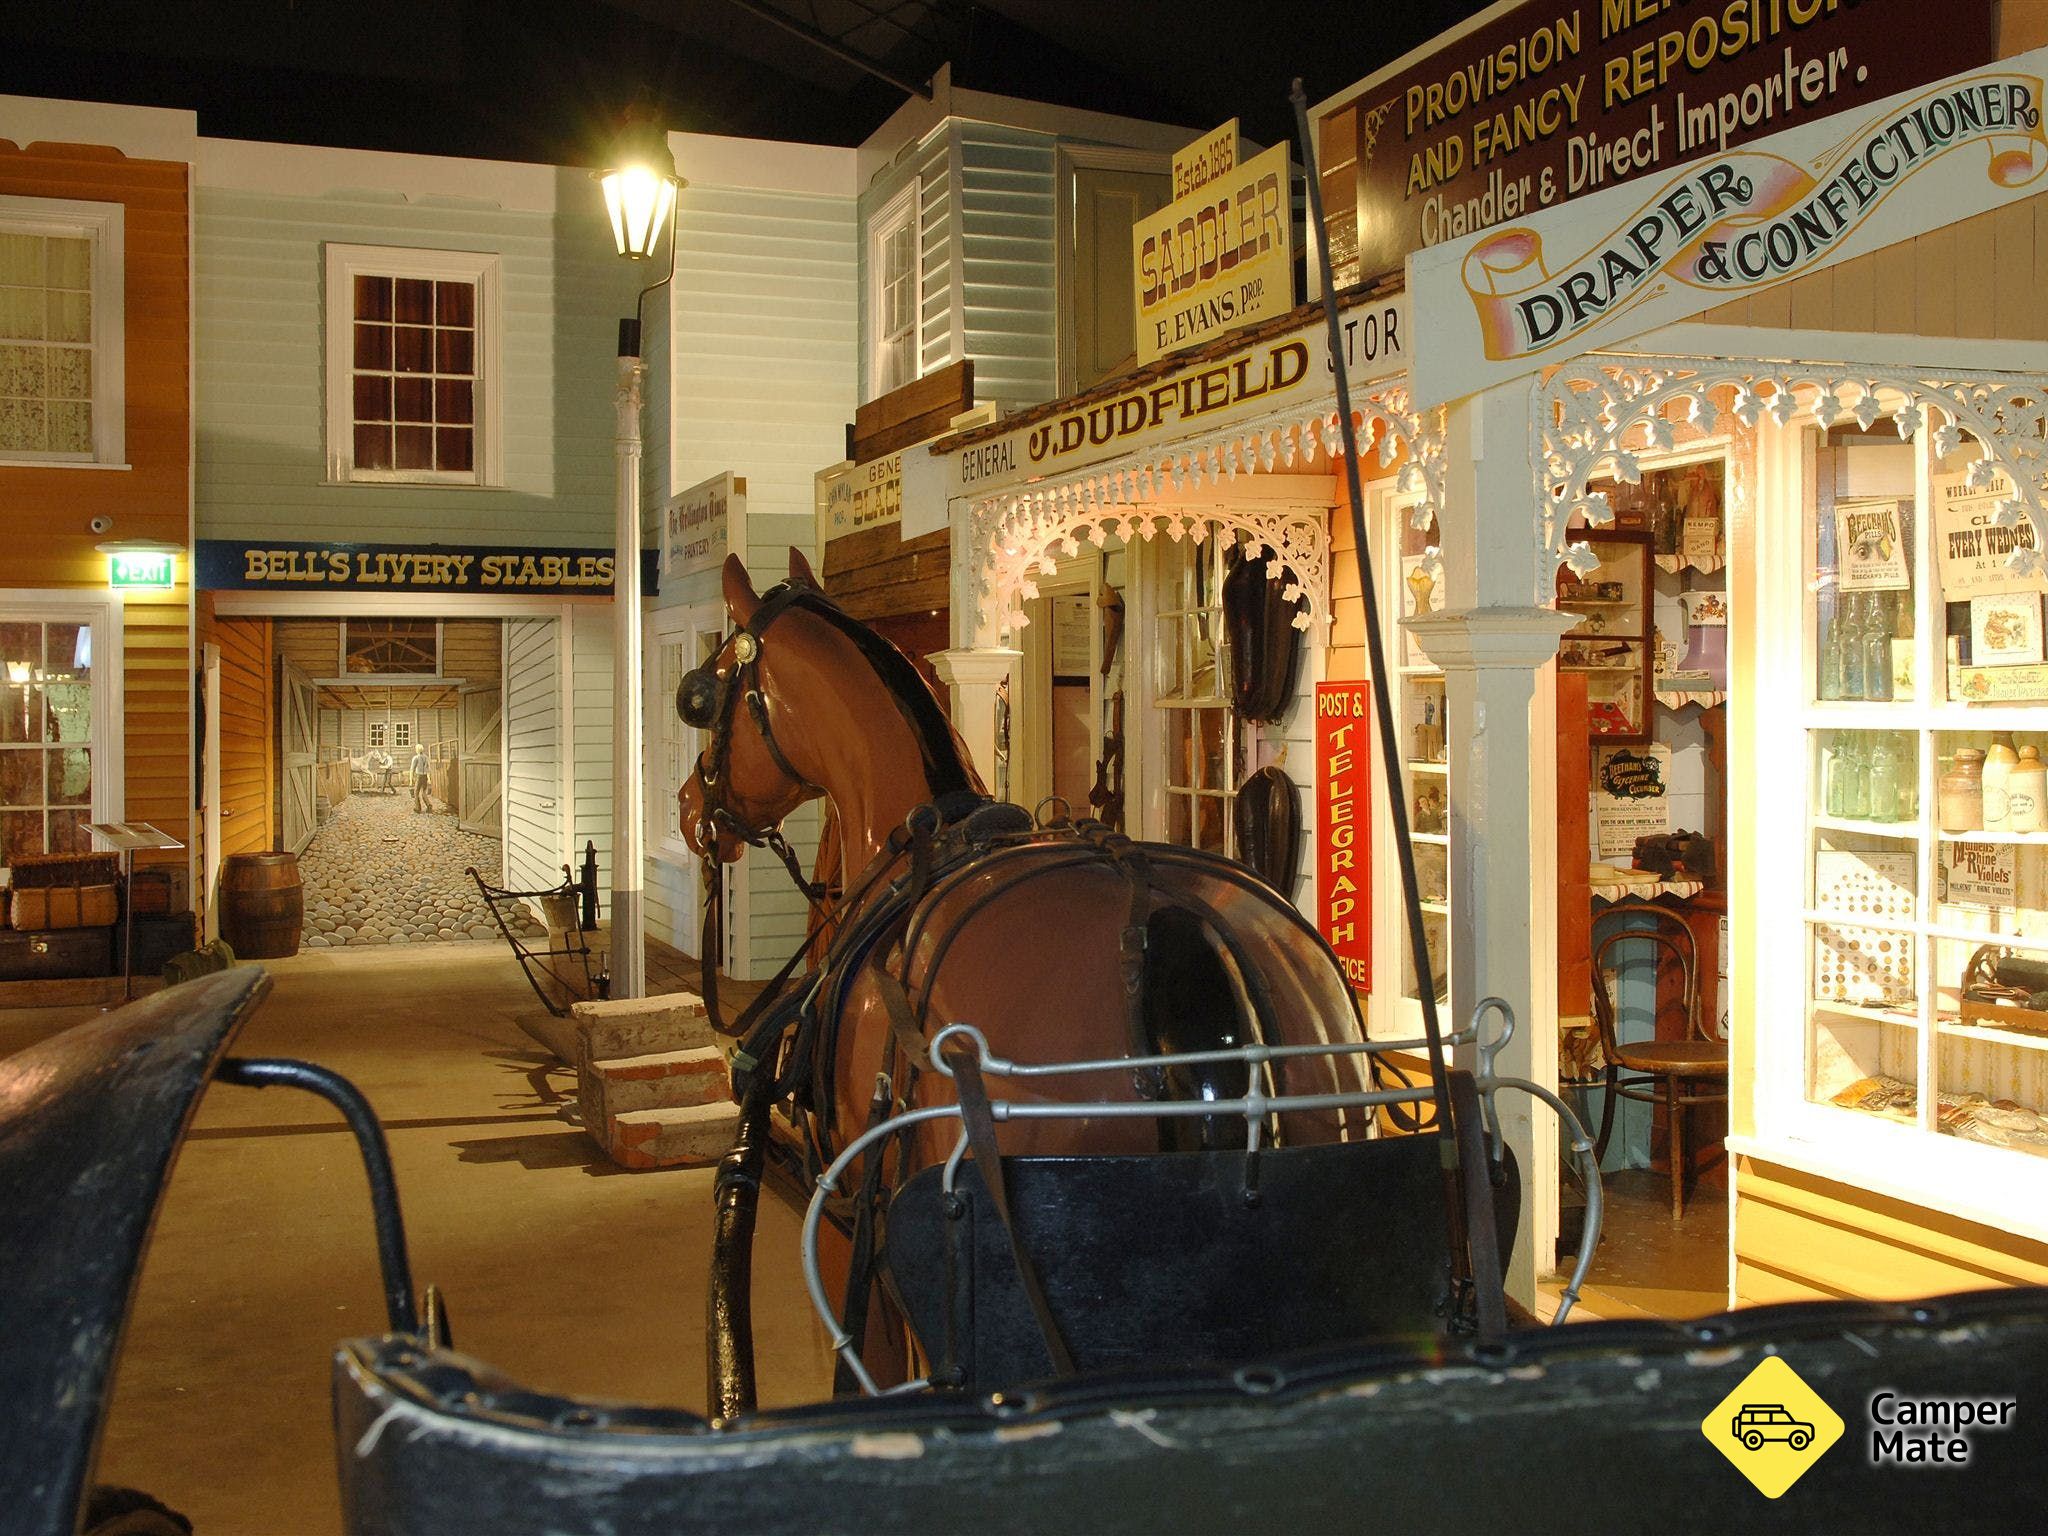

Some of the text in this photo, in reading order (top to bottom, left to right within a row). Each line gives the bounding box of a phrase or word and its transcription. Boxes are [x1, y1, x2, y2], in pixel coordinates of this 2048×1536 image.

[1405, 9, 1581, 135] PROVISION
[1406, 134, 1465, 197] AND
[1473, 74, 1587, 168] FANCY
[1421, 46, 1868, 248] Chandler & Direct Importer.
[1141, 172, 1283, 308] SADDLER
[1514, 162, 1754, 350] DRAPER
[962, 438, 1016, 484] GENERAL
[244, 549, 615, 587] BELL'S LIVERY STABLES
[1846, 509, 1897, 556] BEECHAM'S
[1864, 530, 1882, 539] PILLS
[1948, 529, 1982, 560] EVERY
[1319, 692, 1364, 718] POST &
[1329, 724, 1357, 946] TELEGRAPH
